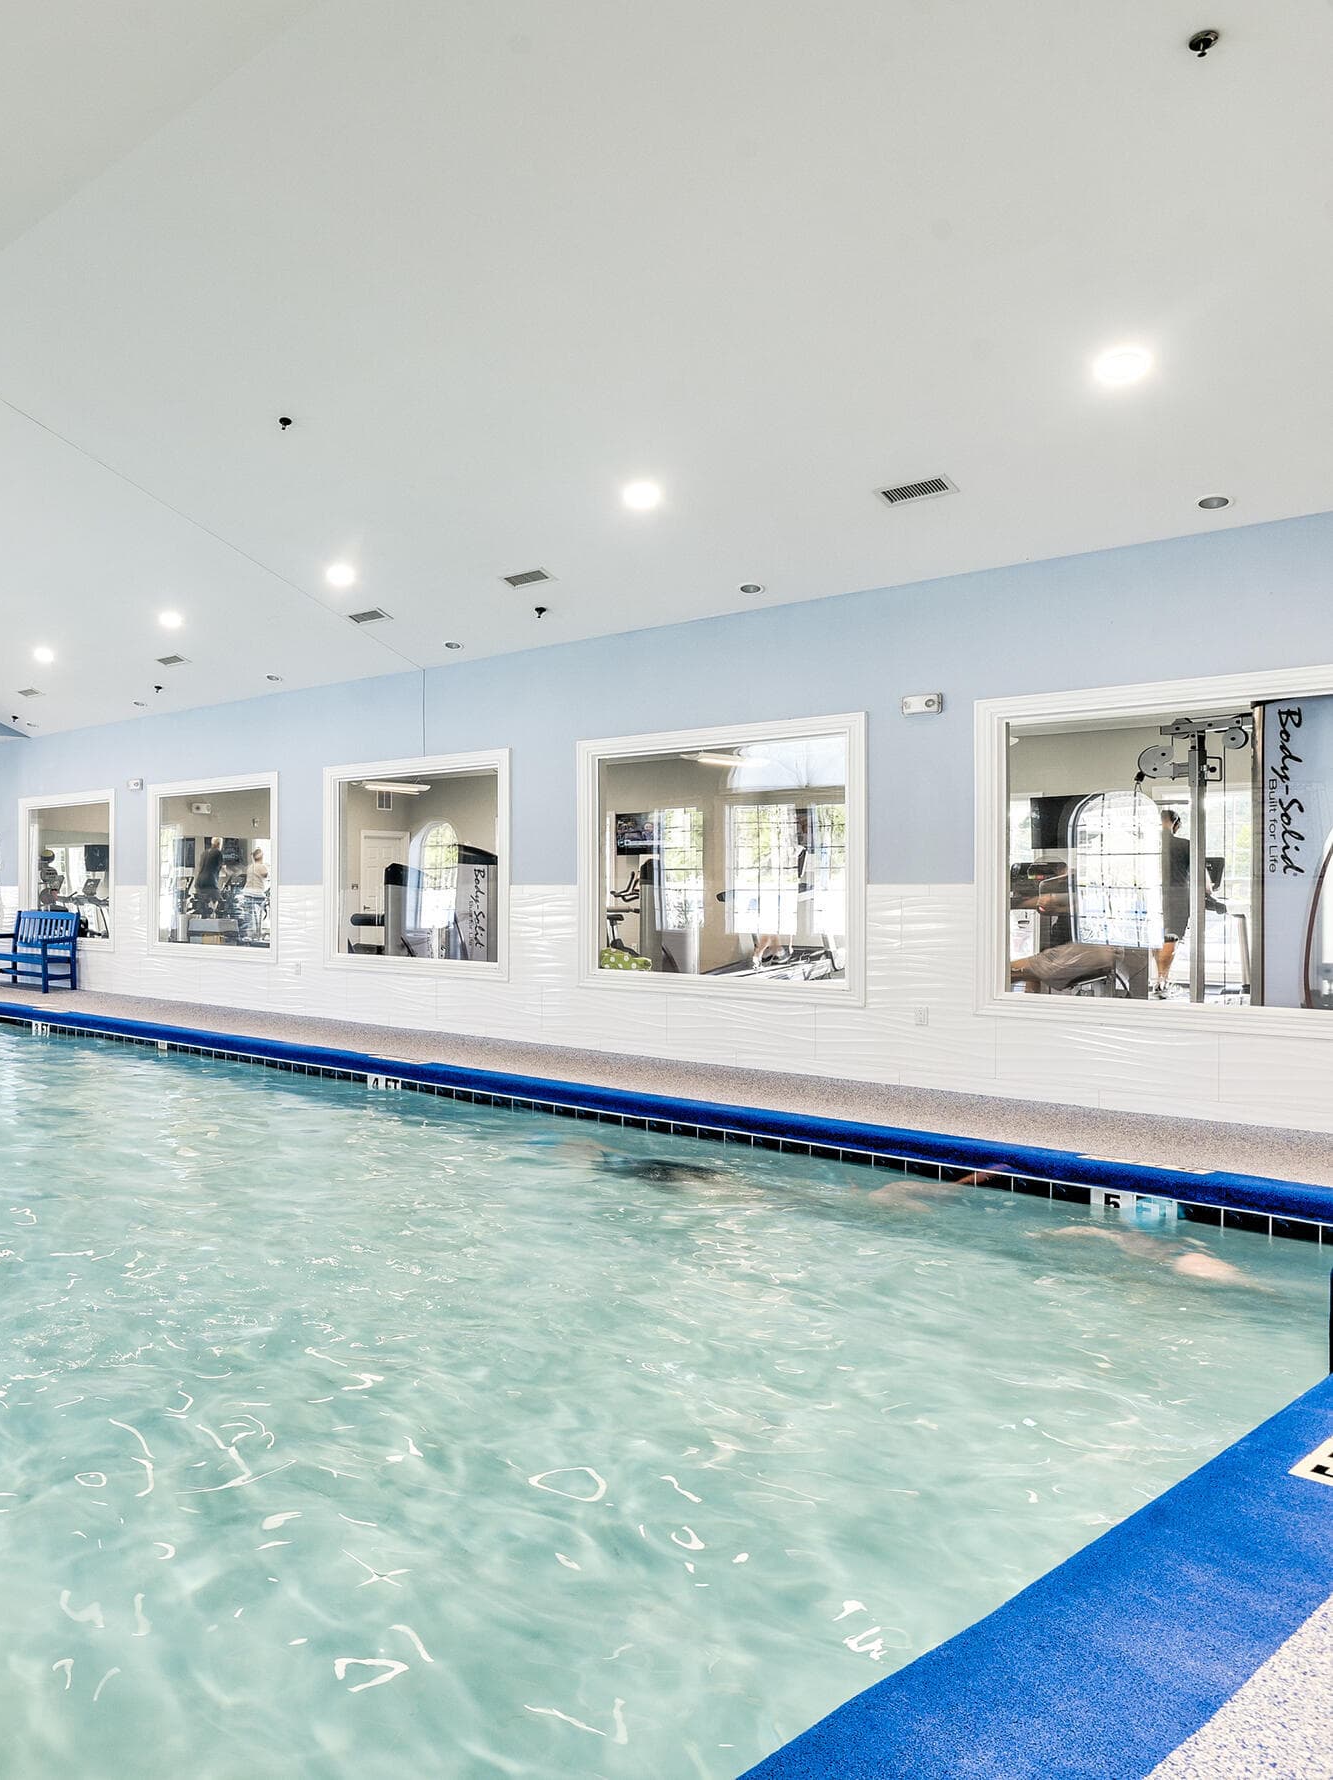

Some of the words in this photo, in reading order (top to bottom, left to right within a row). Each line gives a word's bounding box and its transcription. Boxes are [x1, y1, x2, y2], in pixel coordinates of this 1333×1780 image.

[1268, 778, 1278, 813] Built
[1268, 820, 1279, 840] for
[1268, 845, 1279, 873] Life
